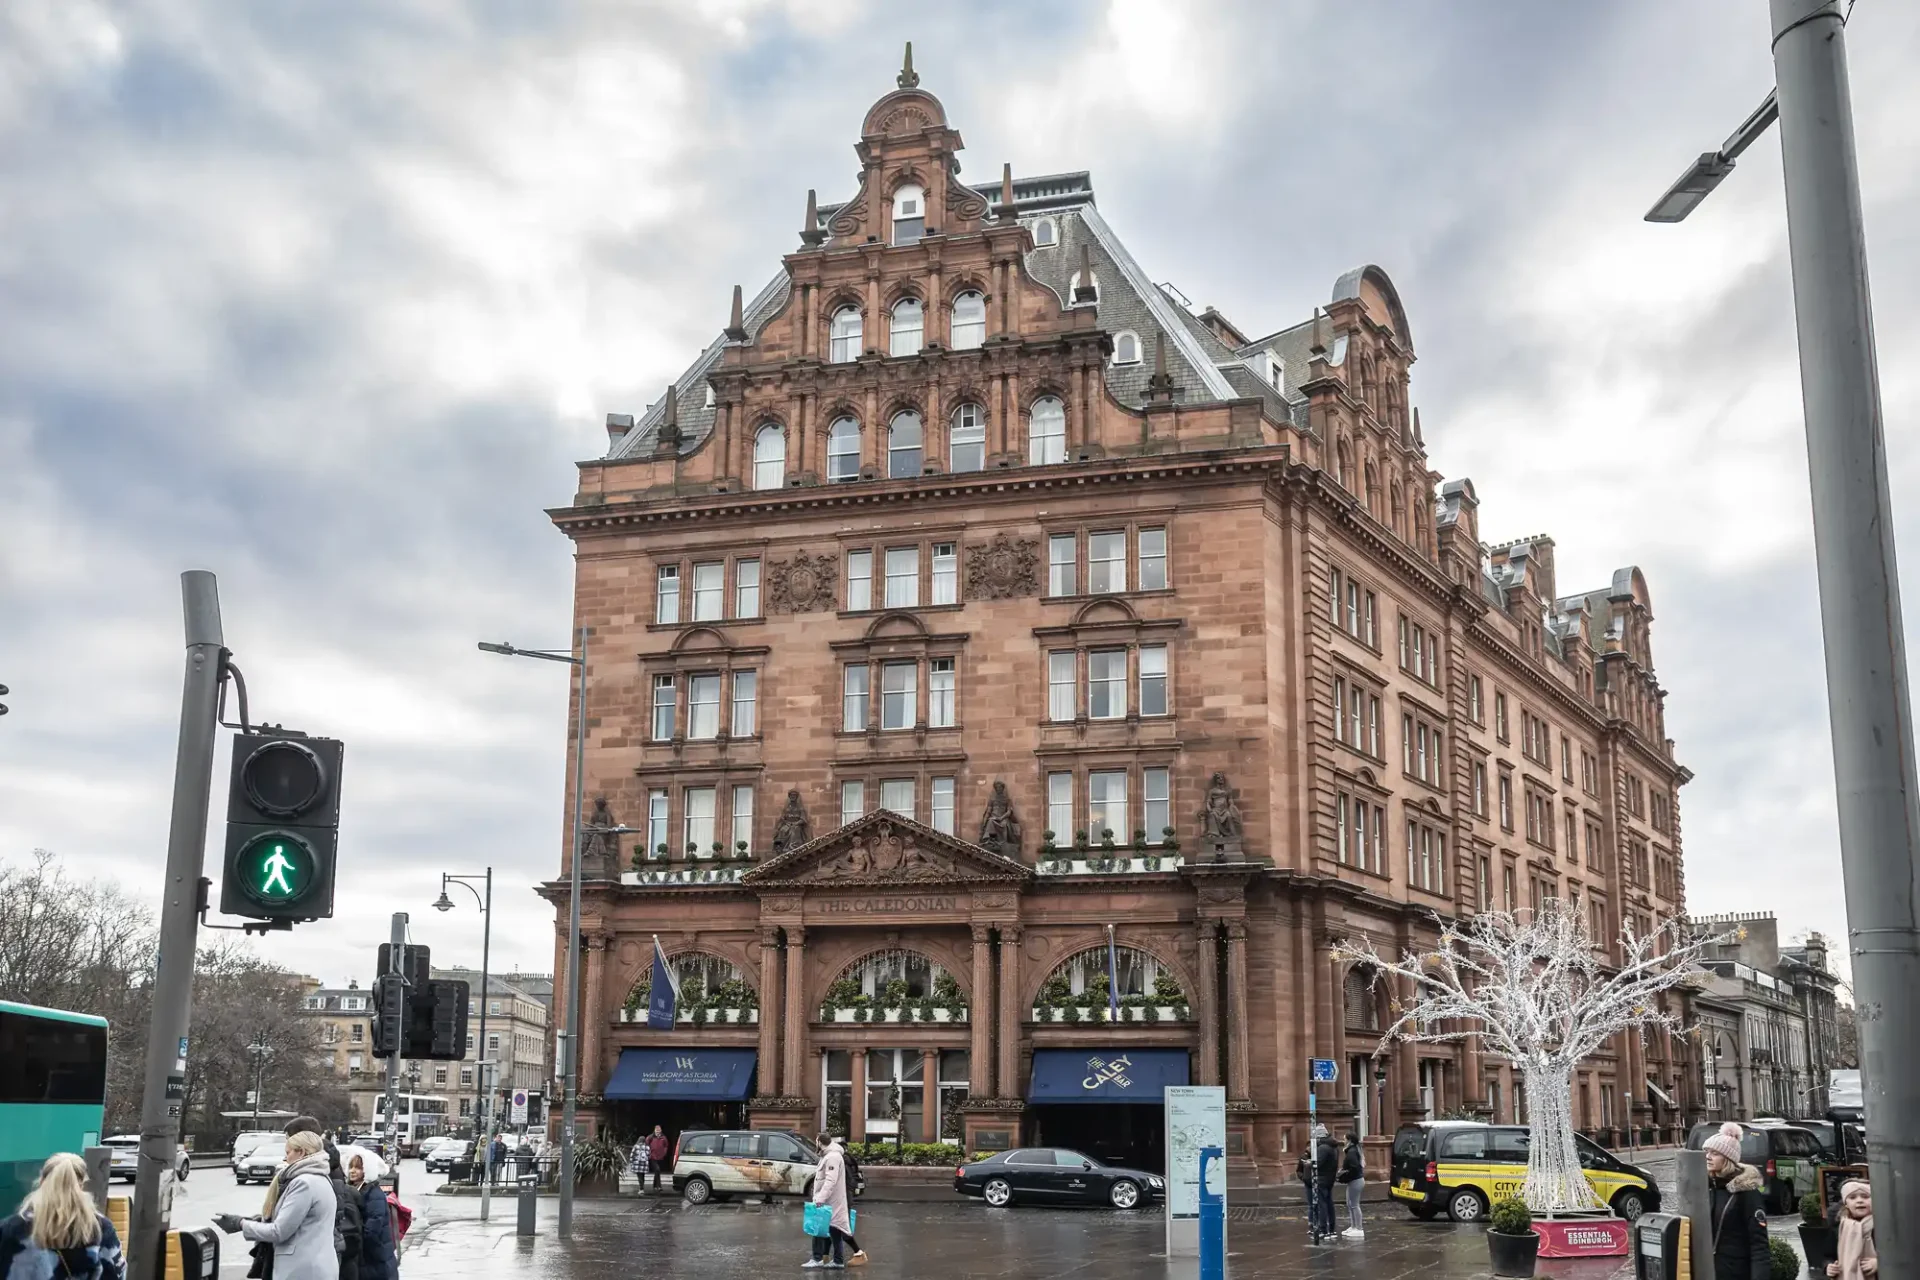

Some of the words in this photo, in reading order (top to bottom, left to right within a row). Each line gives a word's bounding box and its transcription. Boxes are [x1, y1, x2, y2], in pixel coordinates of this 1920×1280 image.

[818, 900, 850, 912] THE
[854, 898, 956, 912] CALEDONIAN
[1088, 1056, 1105, 1069] THE
[1082, 1054, 1132, 1089] CALEY
[1113, 1074, 1131, 1088] BAR
[1494, 1182, 1518, 1191] CITY
[1567, 1231, 1612, 1239] ESSENTIAL
